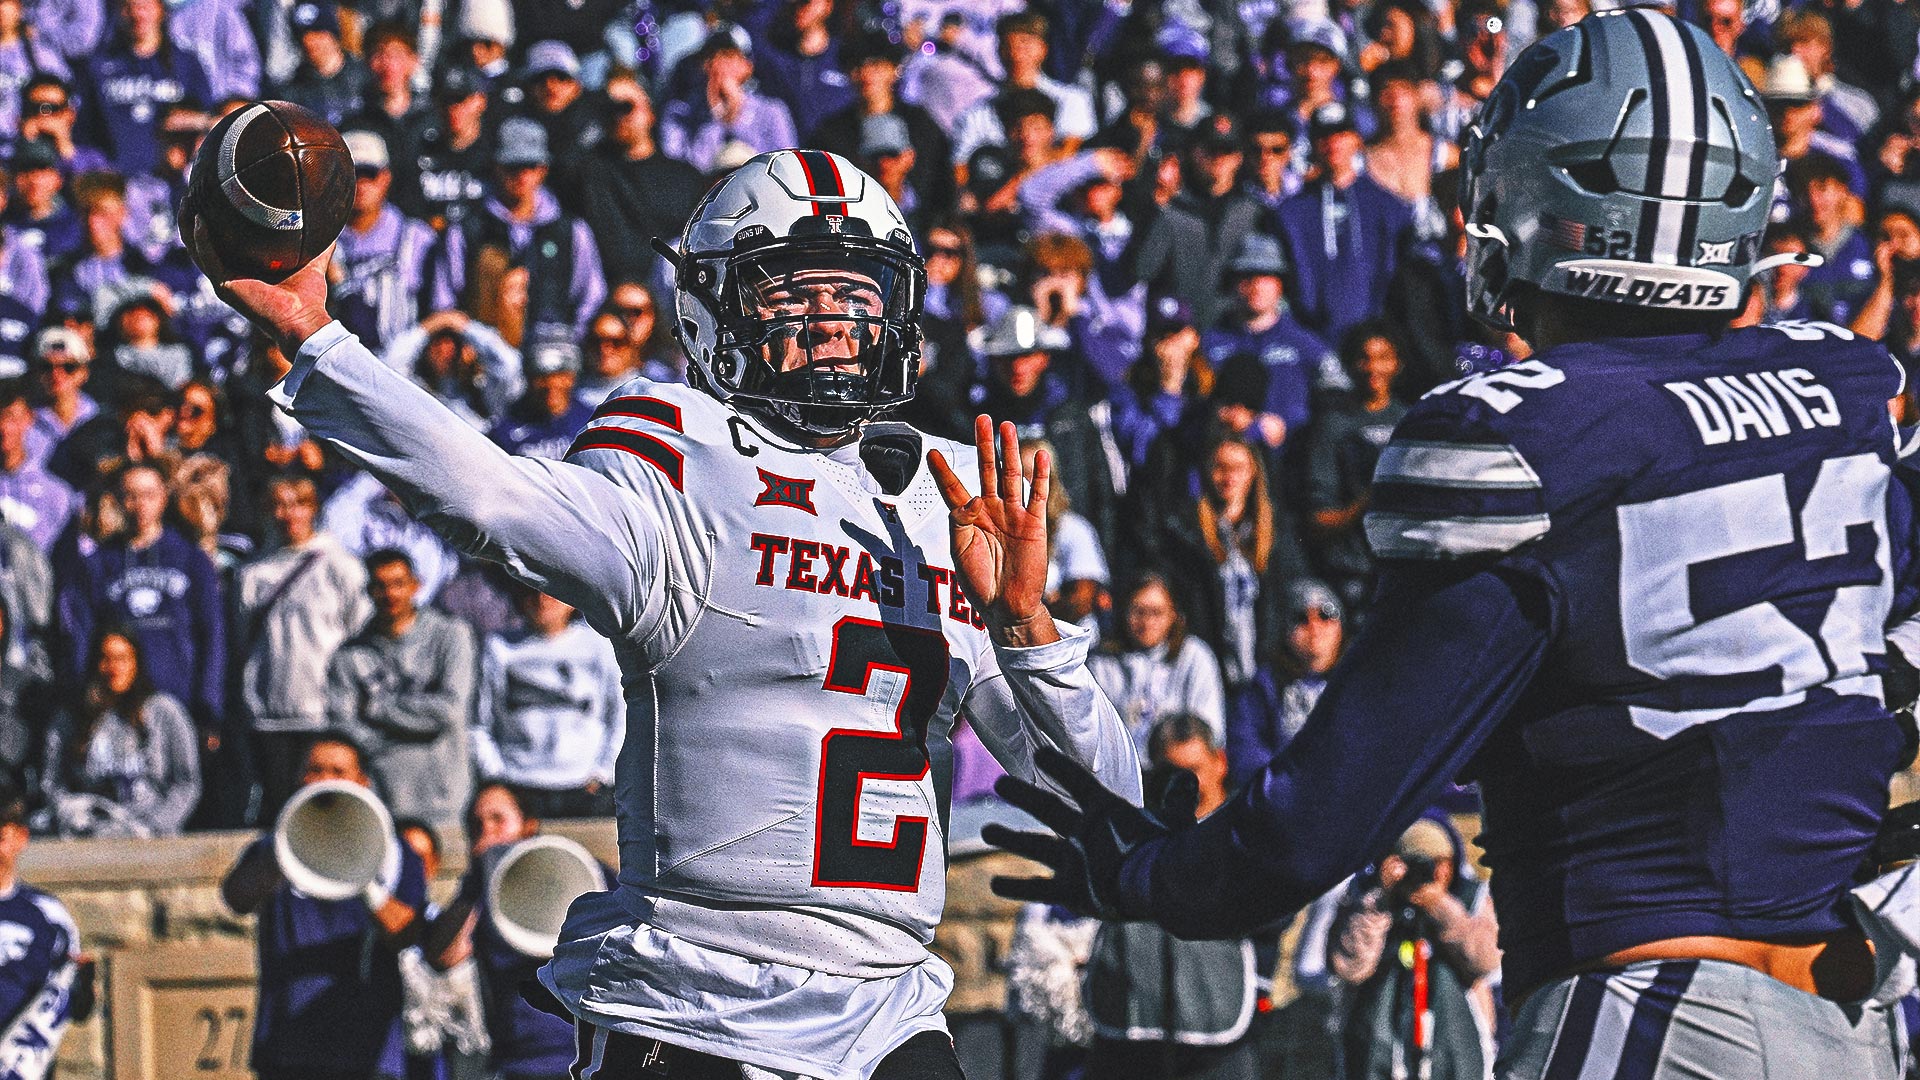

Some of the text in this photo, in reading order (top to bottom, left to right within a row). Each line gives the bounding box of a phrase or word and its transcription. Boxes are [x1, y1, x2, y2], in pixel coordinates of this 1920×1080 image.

[737, 226, 764, 241] GUNS UP
[1587, 225, 1632, 259] 52
[1566, 266, 1730, 306] WILDCATS
[727, 415, 760, 458] C
[1664, 368, 1842, 446] DAVIS
[750, 532, 905, 609] TEXAS
[1616, 452, 1895, 740] 52
[812, 615, 950, 892] 2
[195, 1006, 248, 1071] 27
